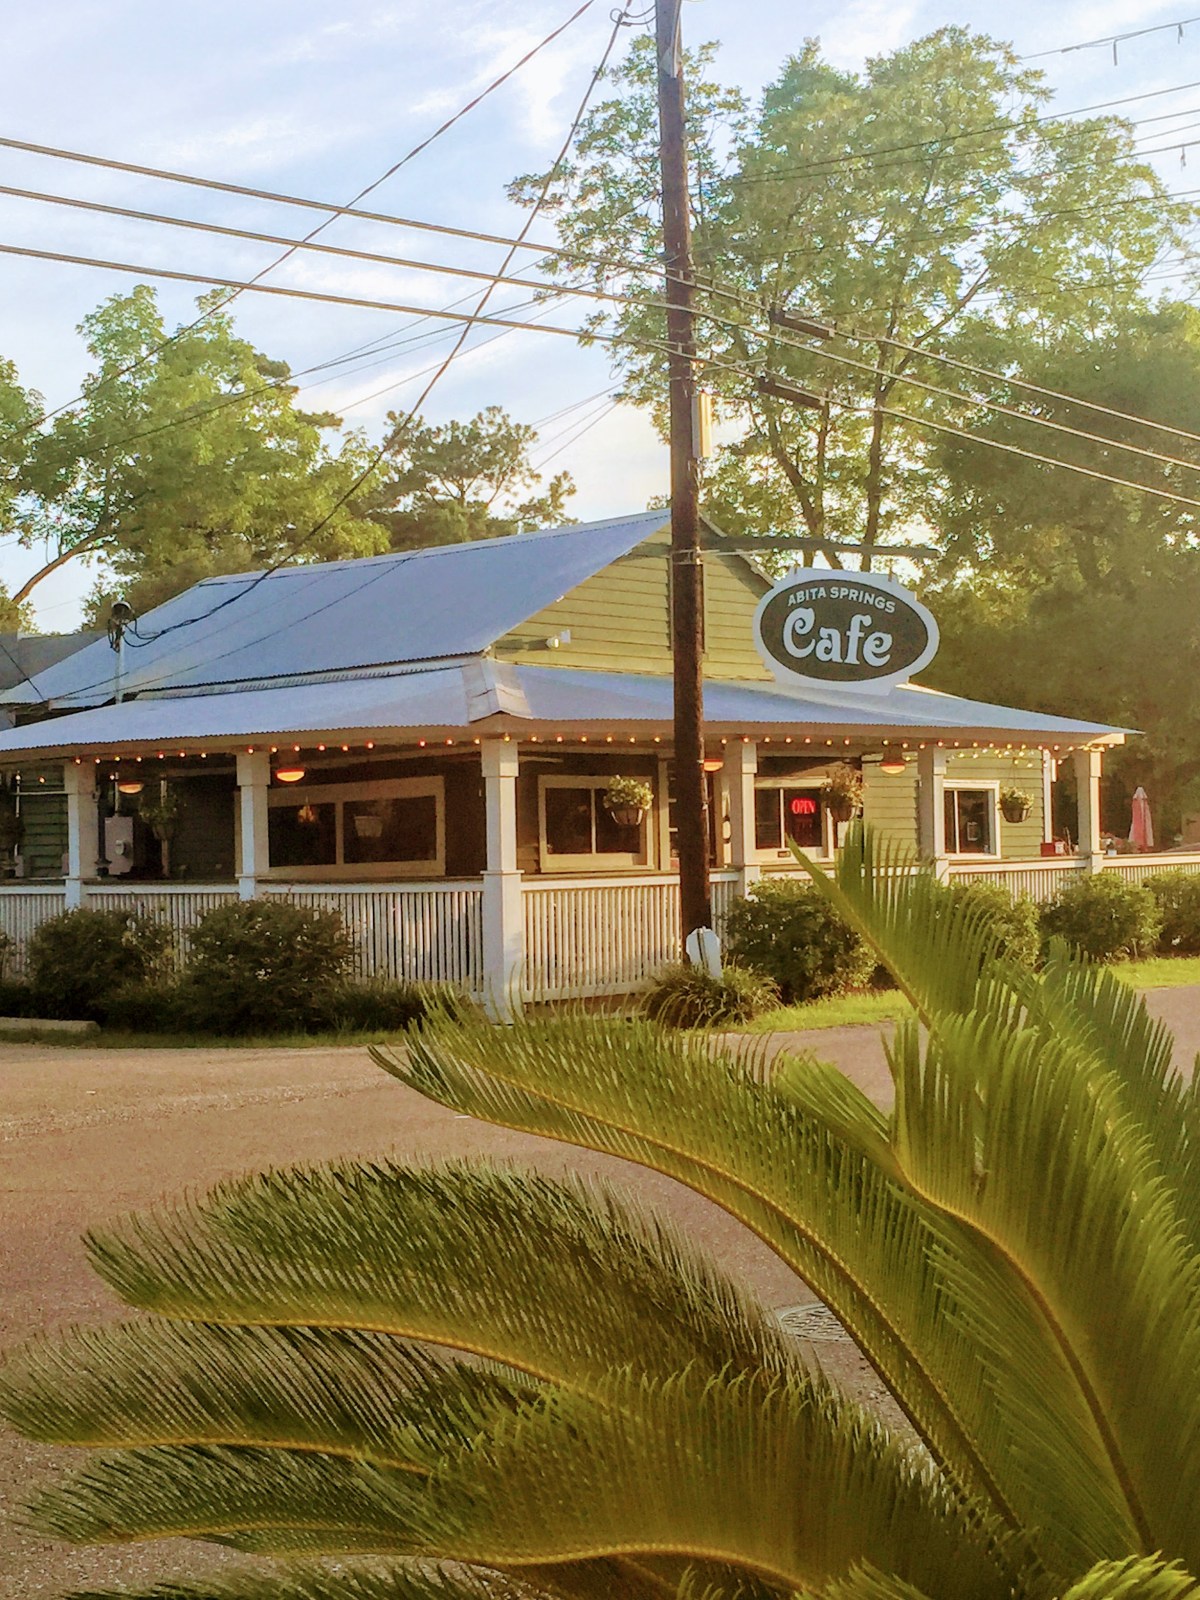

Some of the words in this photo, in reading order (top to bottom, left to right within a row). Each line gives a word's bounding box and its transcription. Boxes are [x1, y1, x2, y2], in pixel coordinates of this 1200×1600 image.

[787, 586, 827, 607] ABITA
[830, 587, 896, 614] SPRINGS
[782, 606, 894, 668] Cafe
[791, 798, 816, 815] OPEN
